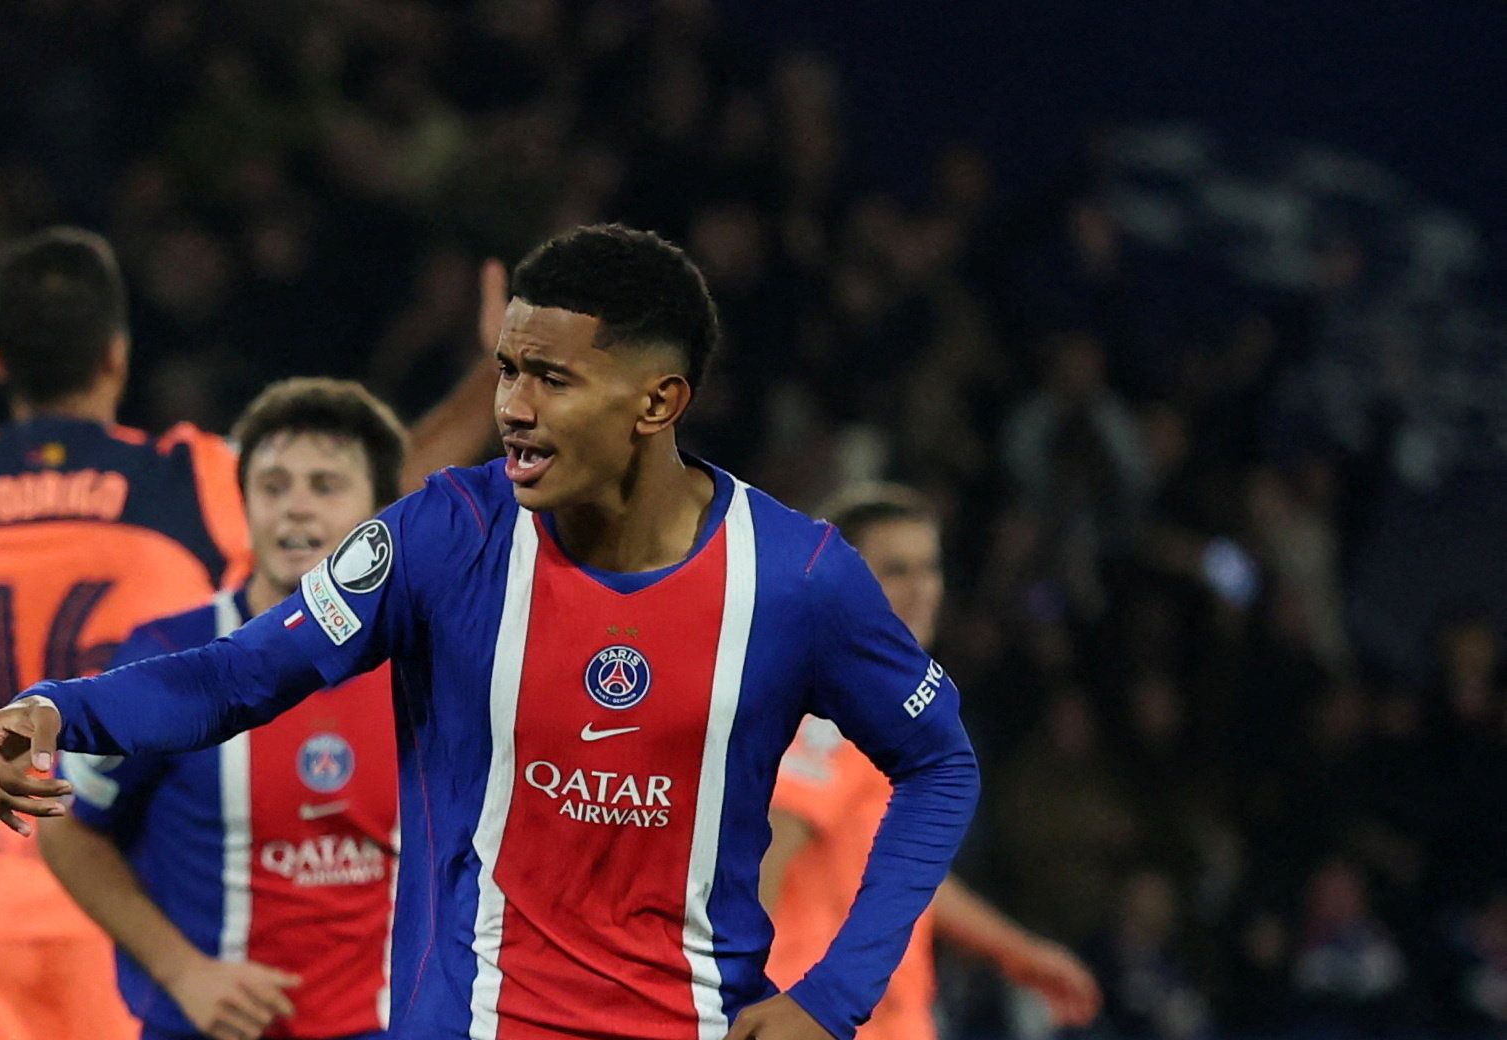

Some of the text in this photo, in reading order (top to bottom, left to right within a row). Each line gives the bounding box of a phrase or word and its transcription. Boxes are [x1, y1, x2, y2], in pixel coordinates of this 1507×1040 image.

[309, 574, 353, 636] NDATION
[599, 649, 641, 667] PARIS
[903, 658, 944, 719] BEYO
[524, 760, 672, 807] QATAR
[559, 799, 670, 828] AIRWAYS
